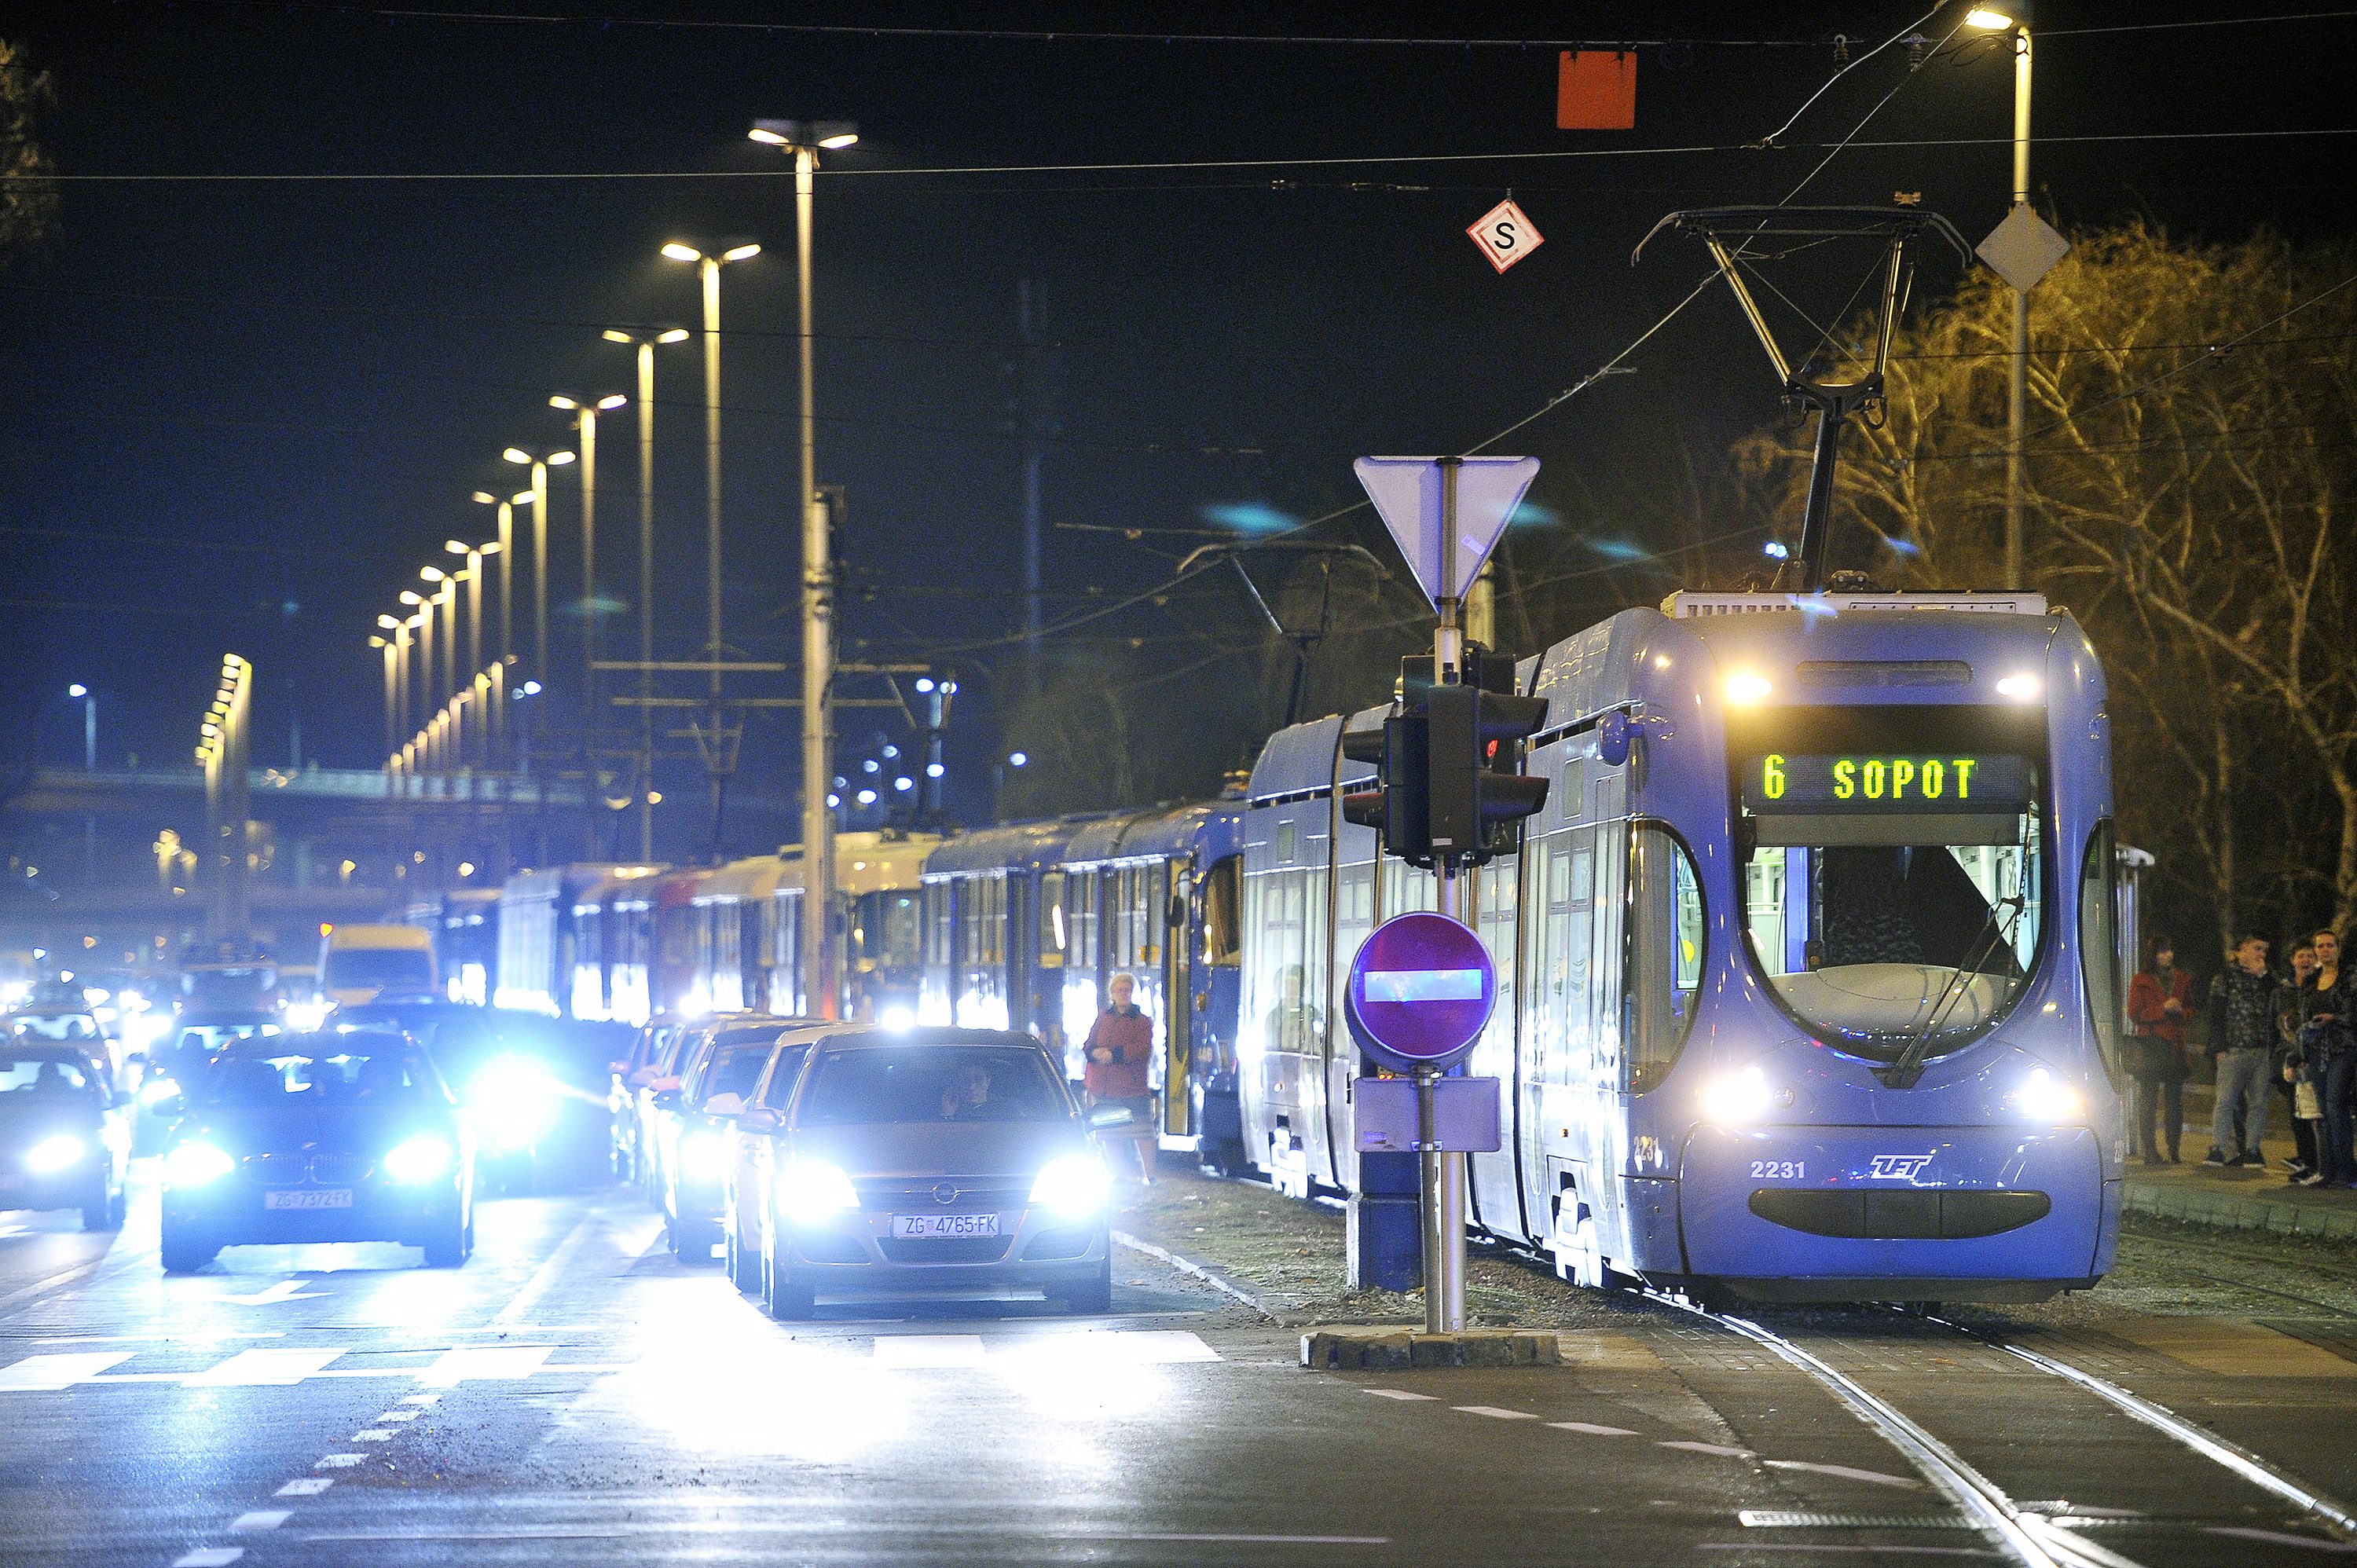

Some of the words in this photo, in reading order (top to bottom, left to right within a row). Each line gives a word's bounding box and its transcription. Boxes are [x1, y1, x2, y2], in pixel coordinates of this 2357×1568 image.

[1494, 222, 1515, 249] S
[1764, 754, 1785, 799] 6
[1834, 759, 1975, 798] SOPOT
[1750, 1162, 1805, 1178] 2231
[905, 1218, 925, 1233] ZG
